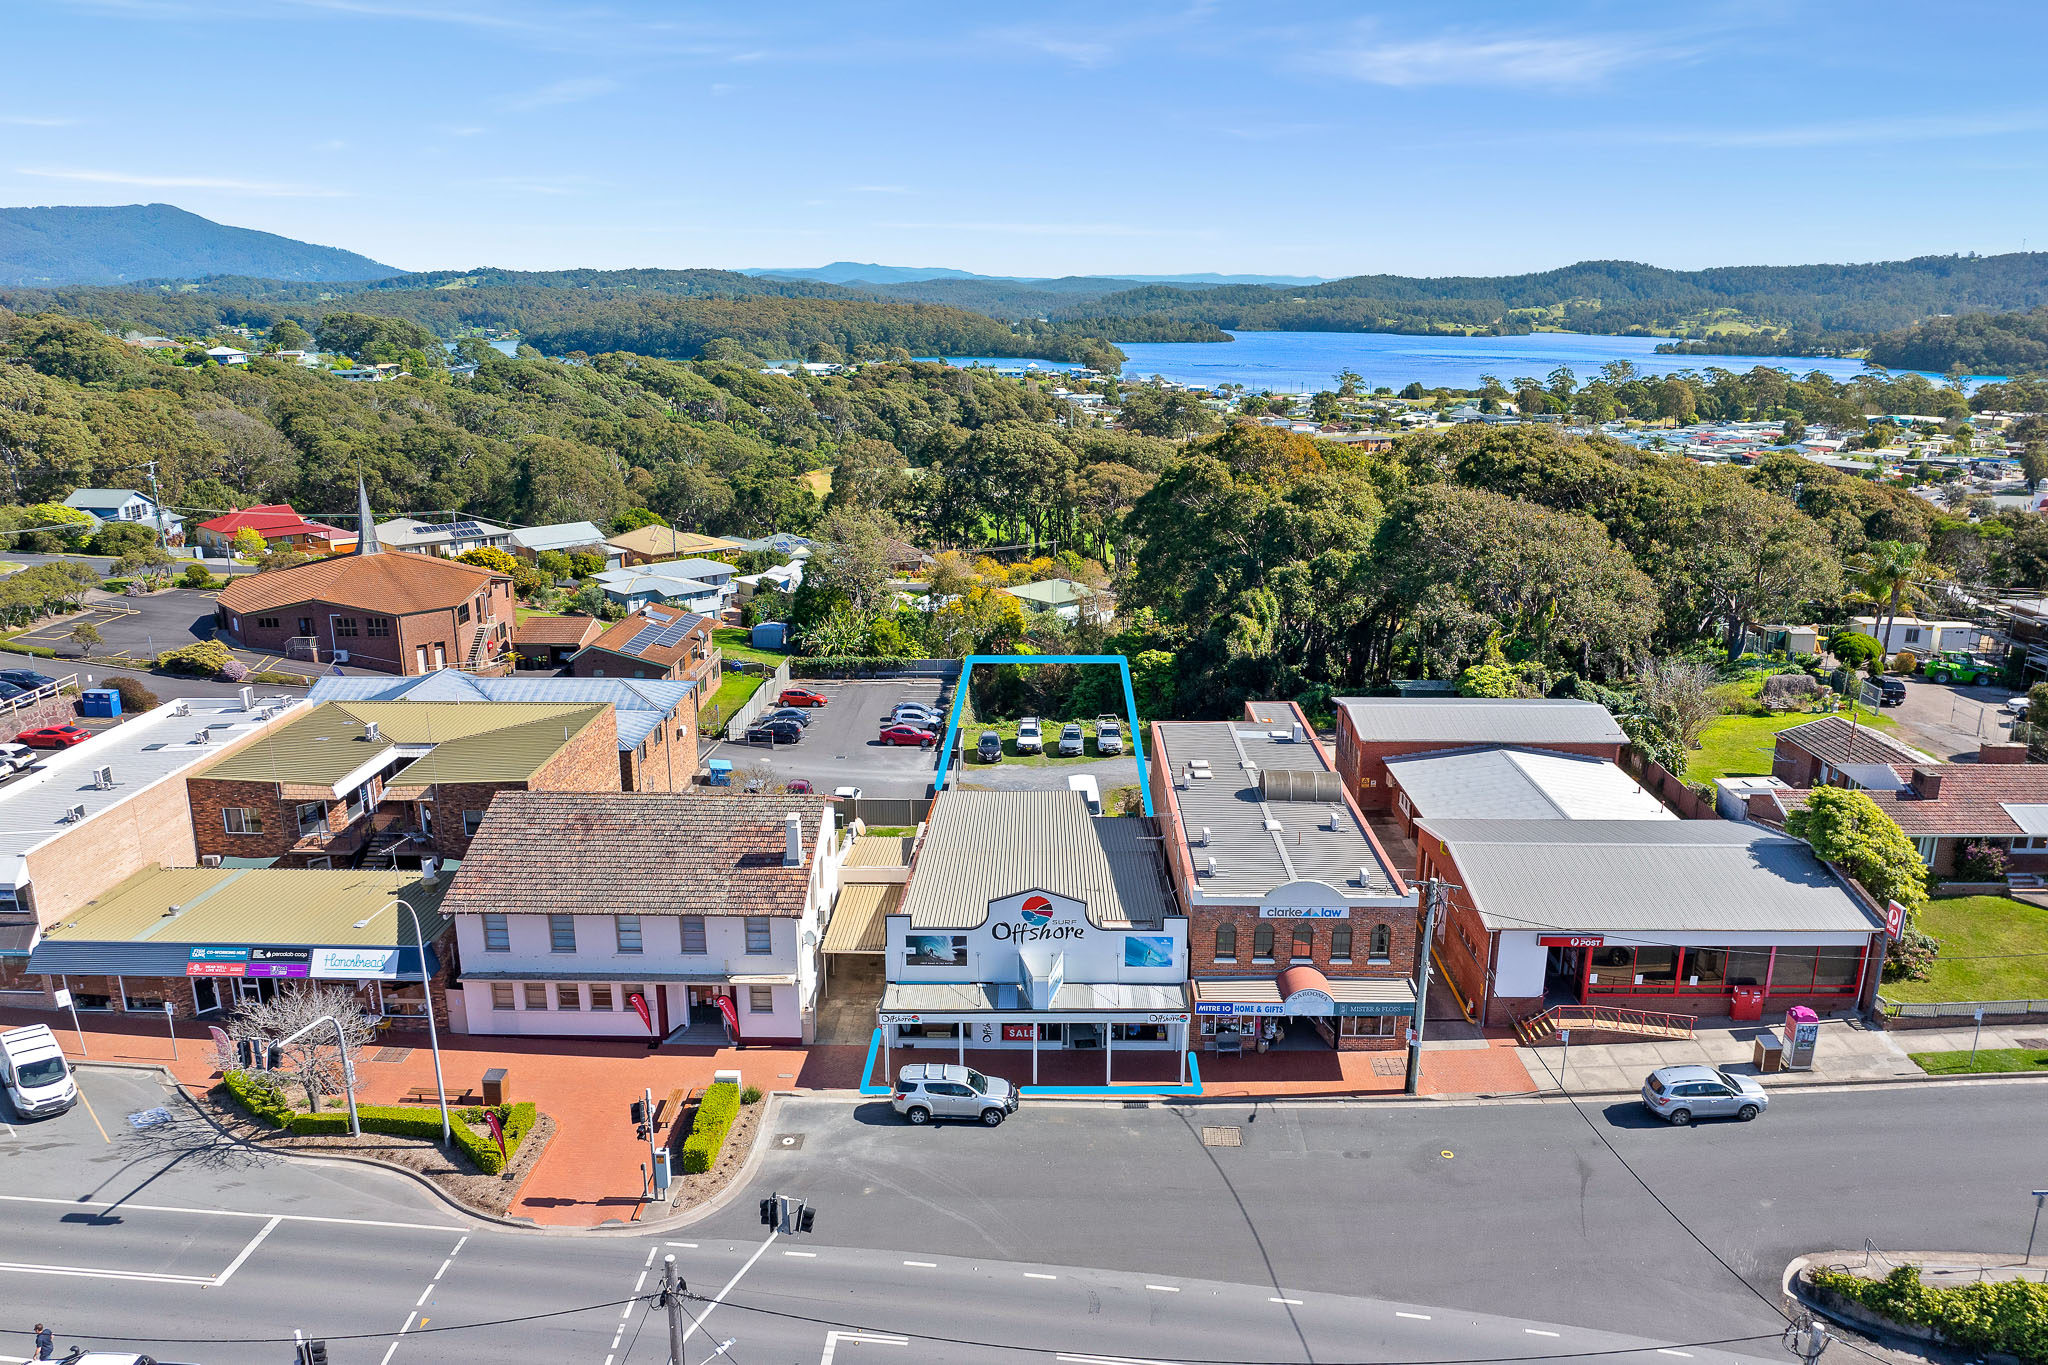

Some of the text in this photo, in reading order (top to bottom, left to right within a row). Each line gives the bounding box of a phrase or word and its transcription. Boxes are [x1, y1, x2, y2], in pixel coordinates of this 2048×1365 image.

[1266, 907, 1342, 917] clarke law
[1887, 923, 1897, 934] POST
[991, 922, 1084, 945] Offshore
[1580, 939, 1601, 947] POST
[1292, 990, 1329, 1002] NAROOMA
[1234, 1005, 1254, 1013] HOME
[1264, 1005, 1284, 1014] GIFTS
[1350, 1005, 1374, 1013] MISTER
[881, 1014, 912, 1023] Offshore
[1149, 1014, 1180, 1023] Offshore
[1009, 1029, 1034, 1038] SALE
